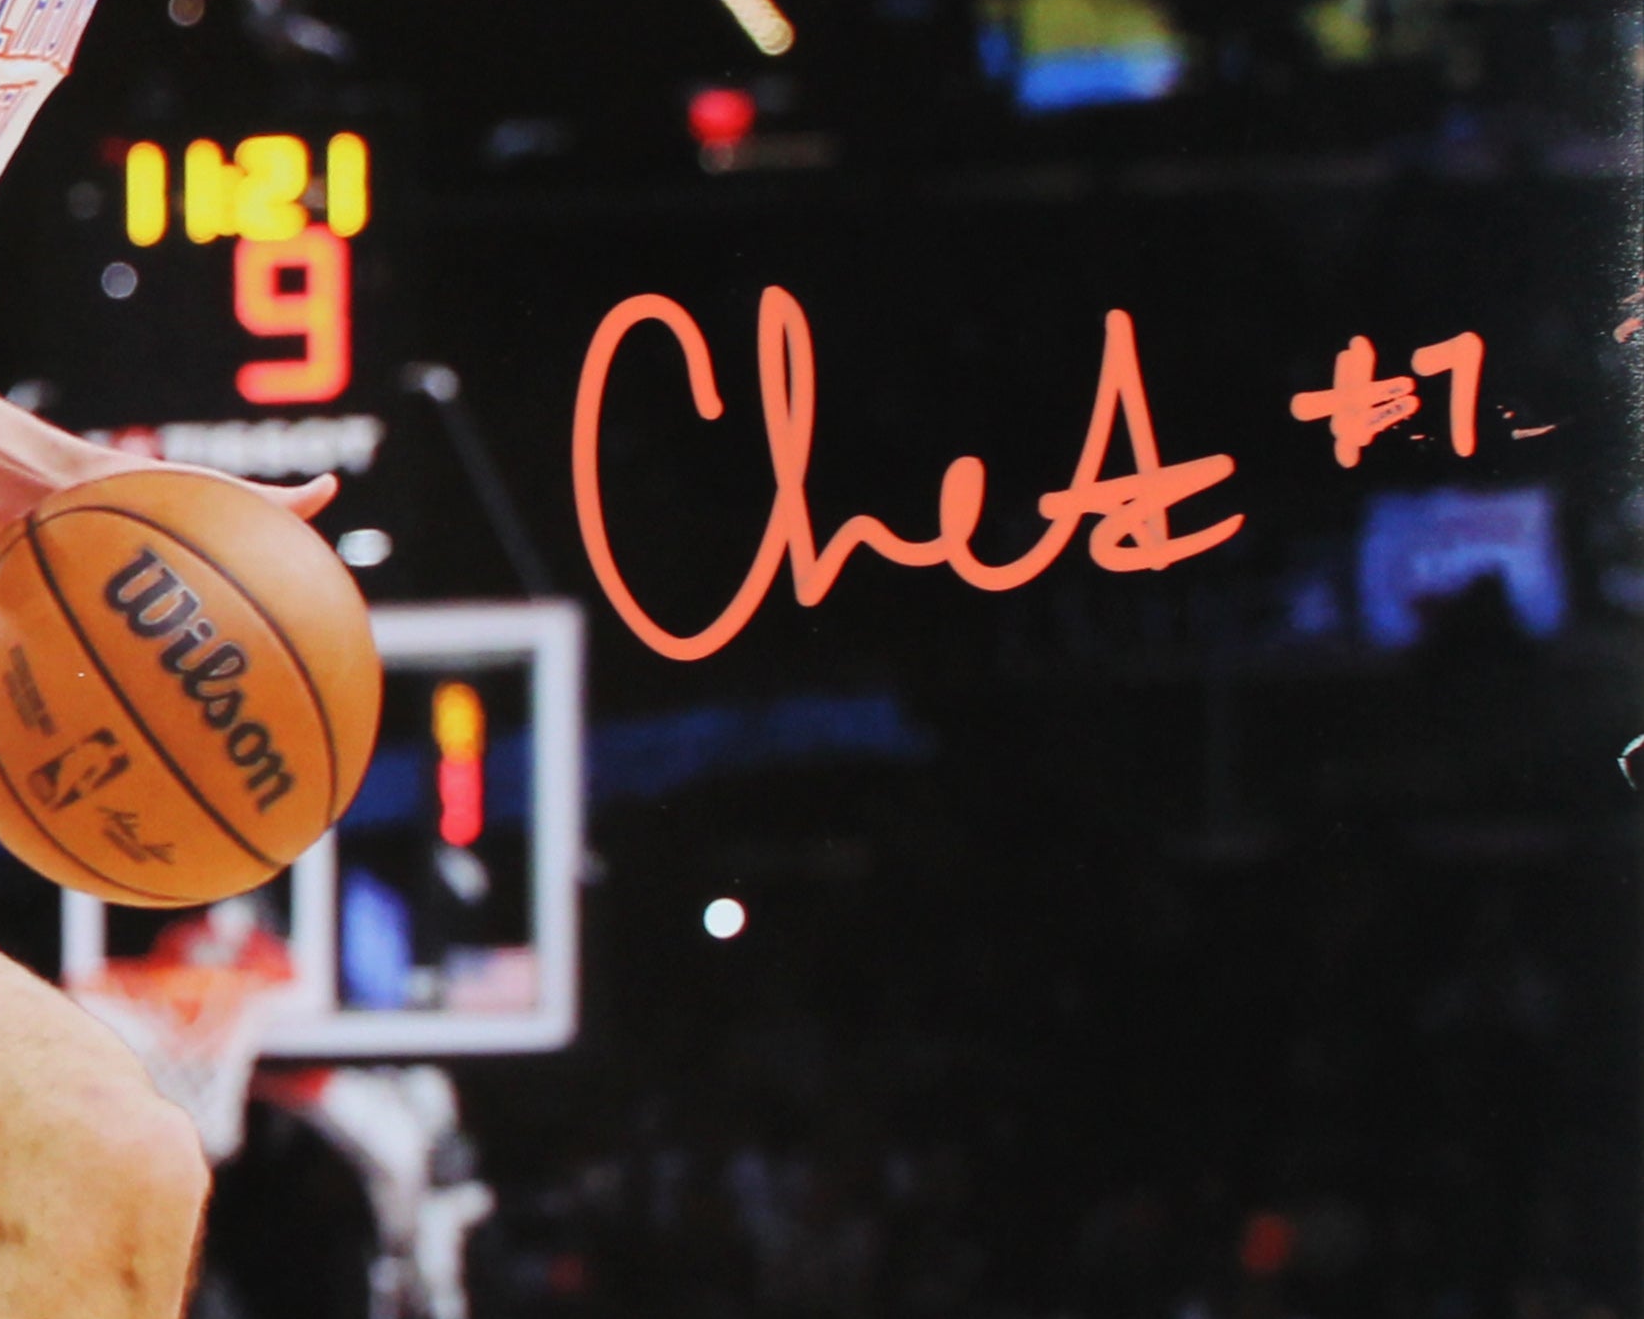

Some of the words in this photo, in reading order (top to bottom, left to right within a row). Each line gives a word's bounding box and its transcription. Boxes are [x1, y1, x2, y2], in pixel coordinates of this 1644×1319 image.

[233, 222, 354, 406] 9
[572, 285, 1245, 661] Chet
[103, 546, 298, 815] Wilson
